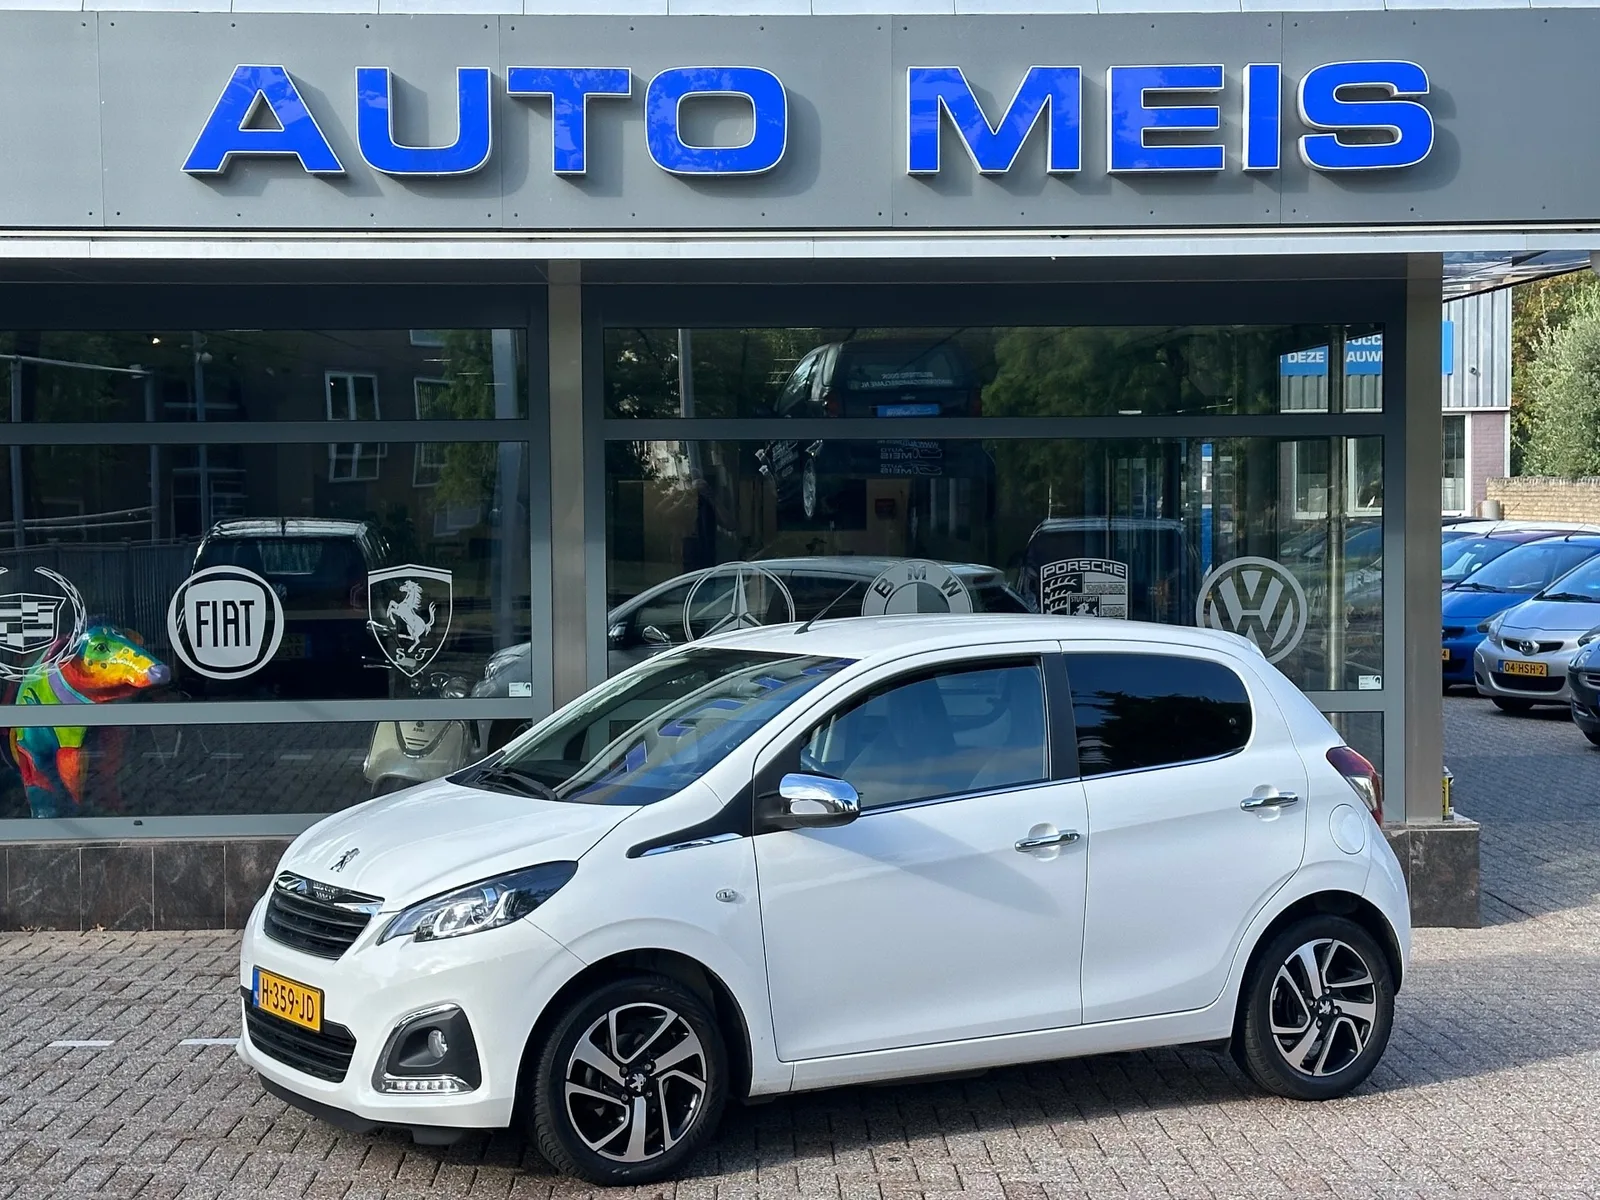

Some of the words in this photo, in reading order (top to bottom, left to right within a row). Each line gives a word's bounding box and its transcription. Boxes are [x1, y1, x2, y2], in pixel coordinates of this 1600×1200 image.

[180, 63, 790, 177] AUTO
[906, 59, 1435, 176] MEIS
[1287, 351, 1325, 363] DEZE
[1345, 350, 1383, 363] AUW
[873, 564, 963, 599] BMW
[1043, 560, 1126, 579] PORSCHE
[195, 599, 255, 648] FIAT
[1504, 661, 1545, 675] 04-HSH-2
[262, 977, 315, 1022] H-359-JD
